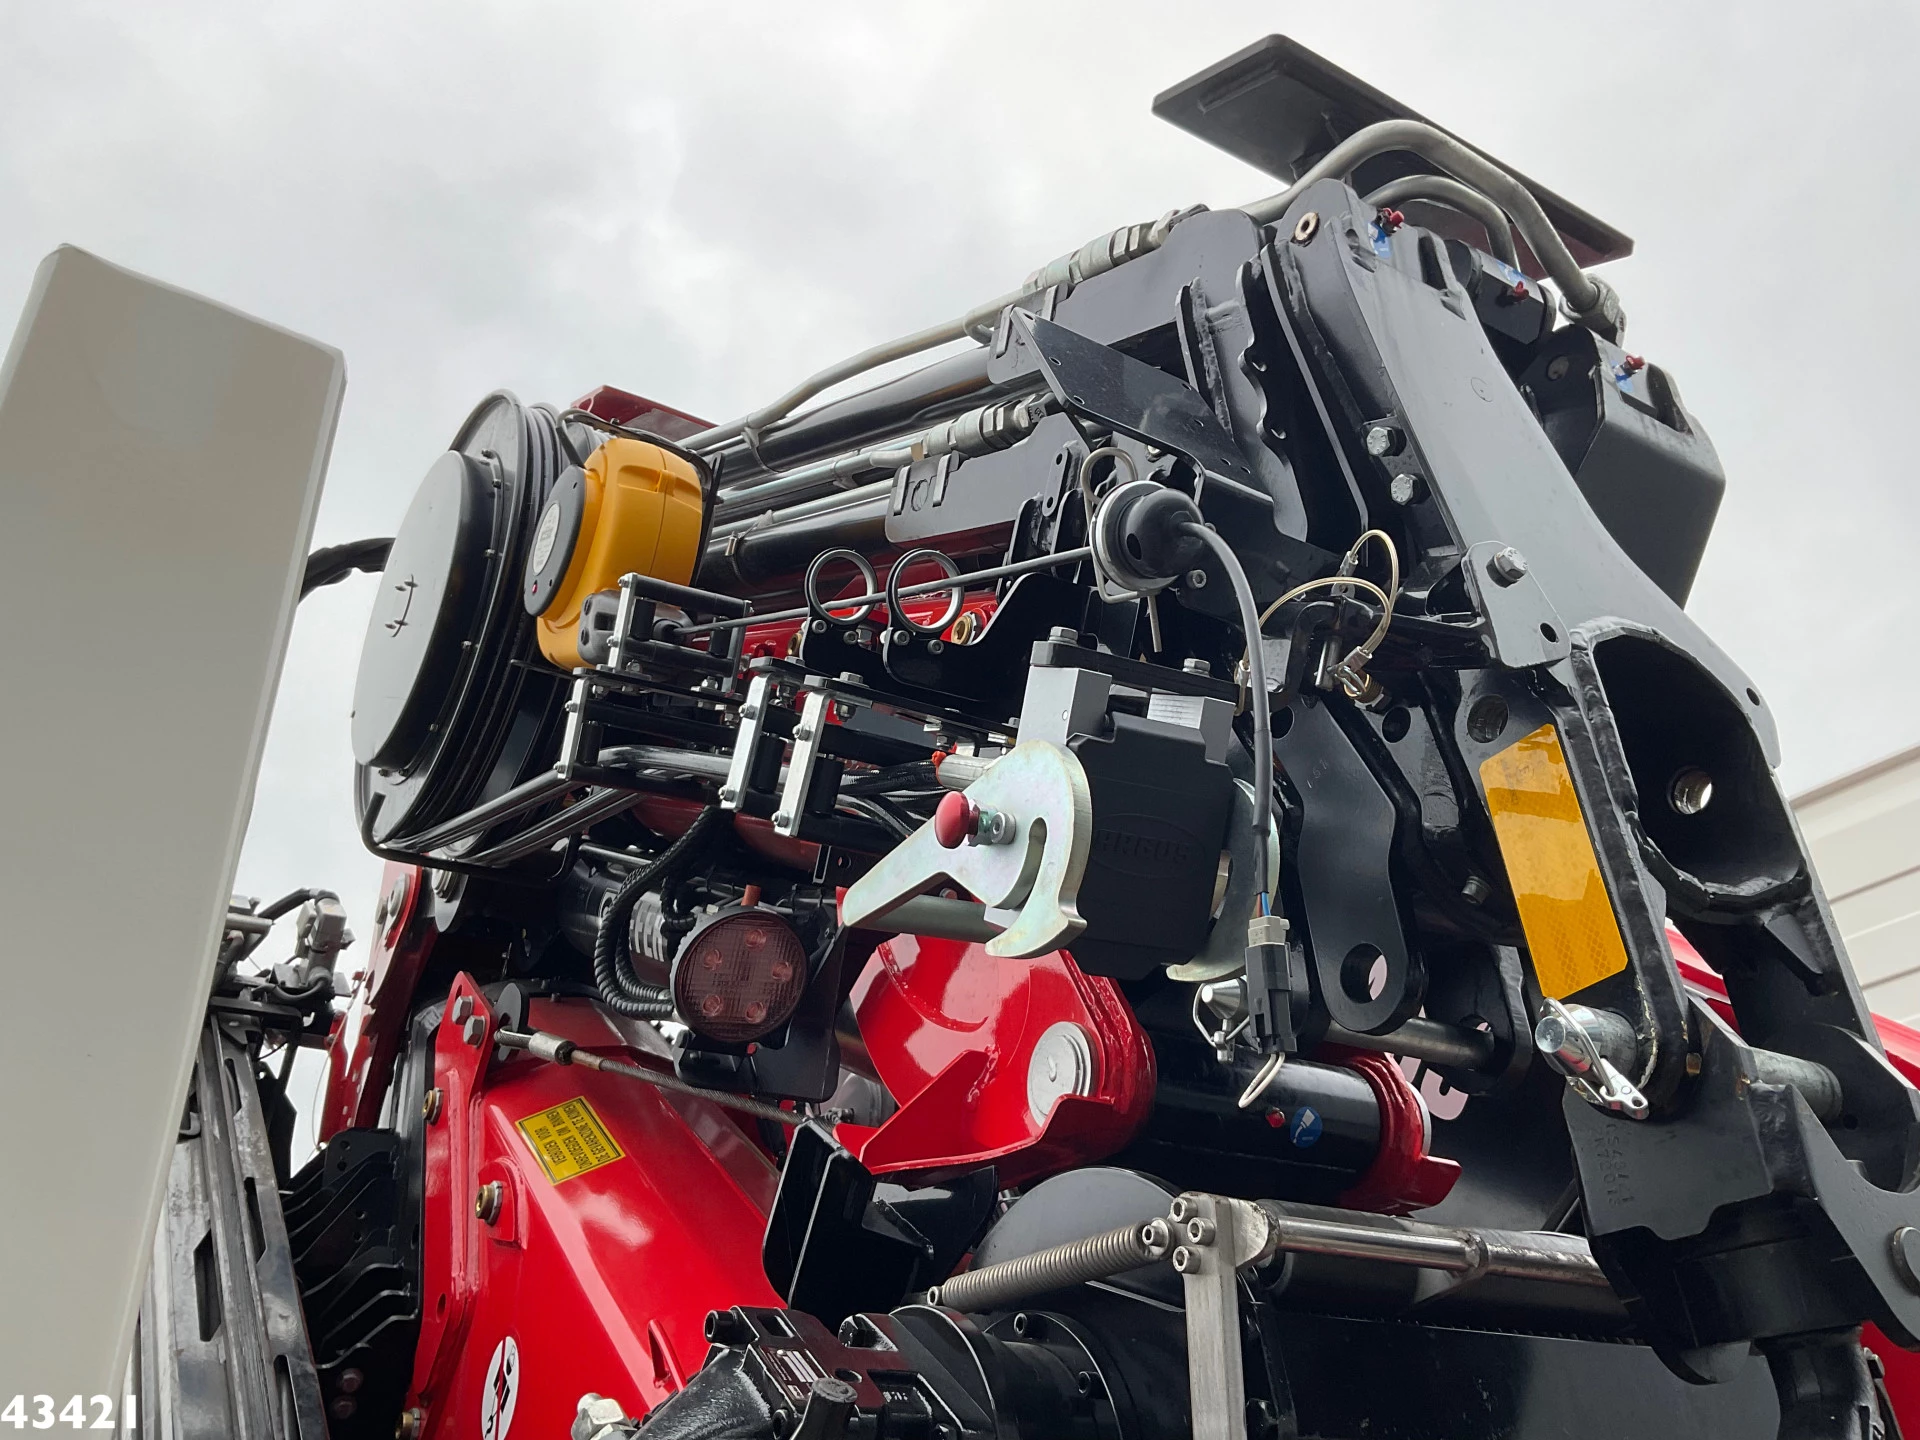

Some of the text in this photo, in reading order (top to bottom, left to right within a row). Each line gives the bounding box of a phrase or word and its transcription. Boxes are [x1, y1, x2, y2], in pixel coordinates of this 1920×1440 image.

[571, 1117, 585, 1126] TE
[534, 1126, 567, 1165] VERBODEN VOOR
[596, 1152, 610, 1162] DE
